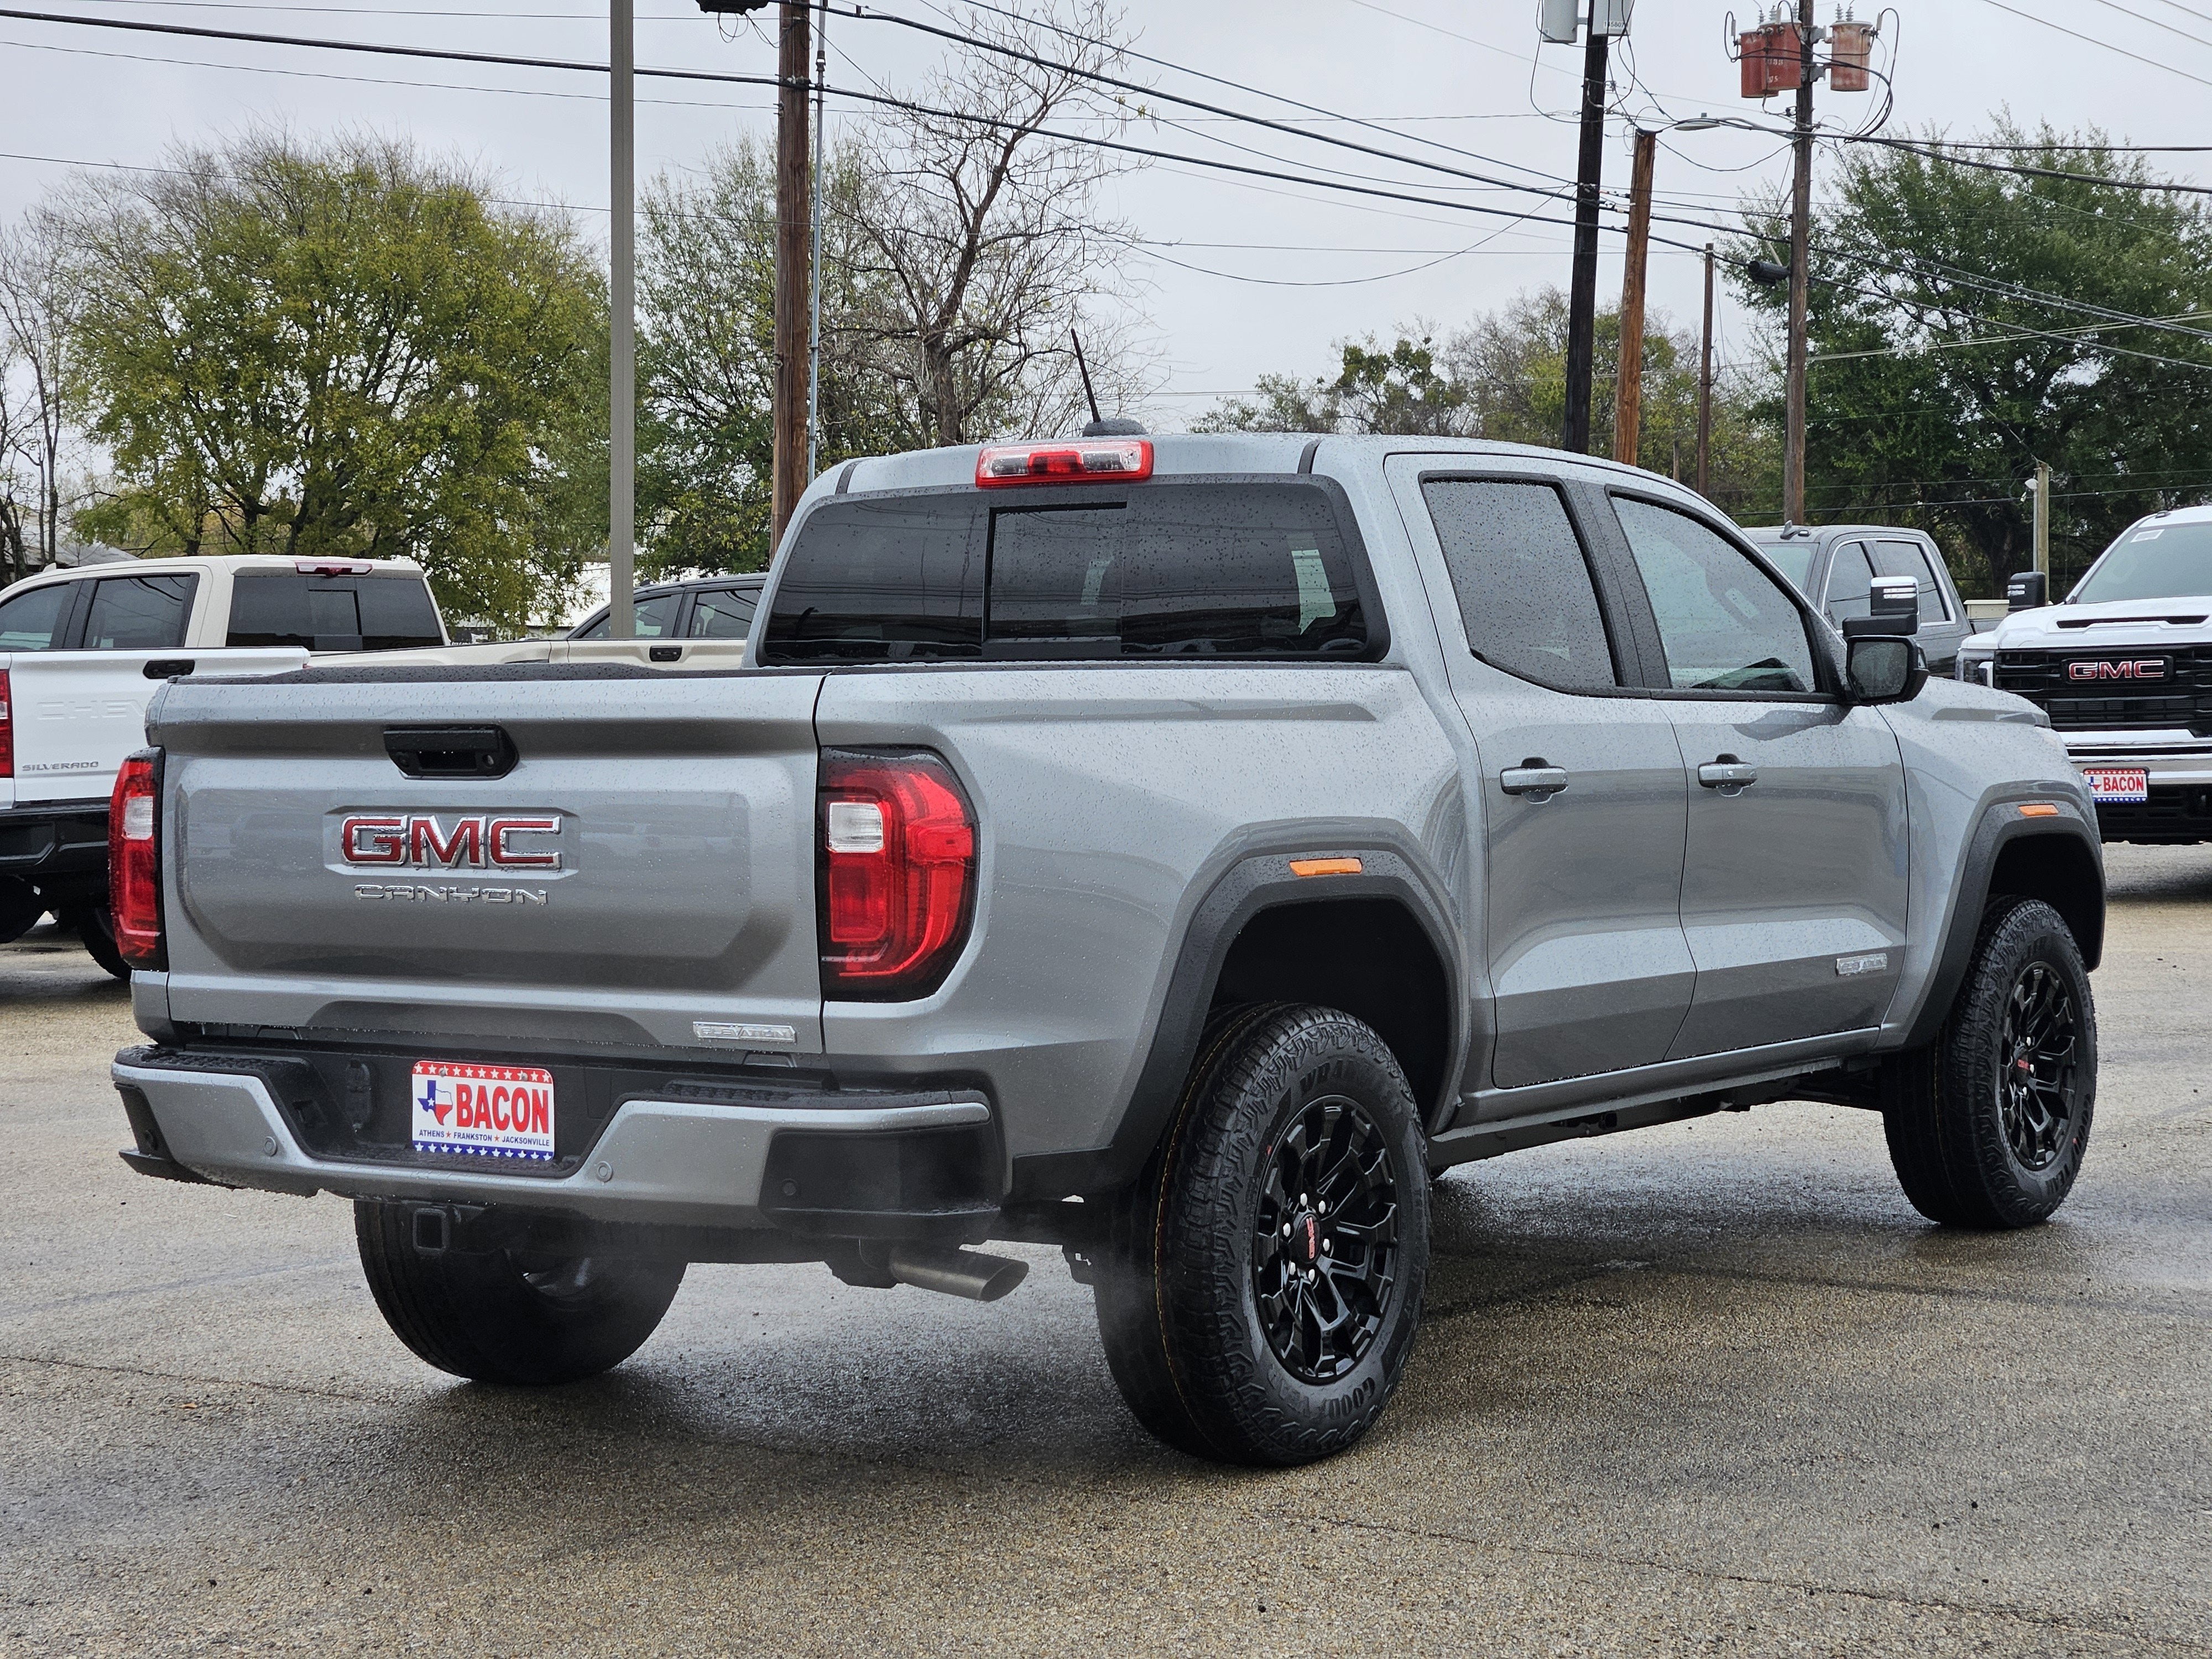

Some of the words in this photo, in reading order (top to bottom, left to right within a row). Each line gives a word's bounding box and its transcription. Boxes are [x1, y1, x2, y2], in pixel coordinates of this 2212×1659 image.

[2069, 660, 2164, 680] GMC
[22, 761, 98, 771] SILVERADO
[2103, 776, 2144, 791] BACON
[342, 815, 561, 872] GMC
[354, 885, 547, 905] CANYON
[456, 1083, 549, 1134] BACON
[419, 1129, 445, 1138] ATHENS
[453, 1133, 492, 1142] FRANKSTON
[502, 1137, 550, 1146] JACKSONVILLE
